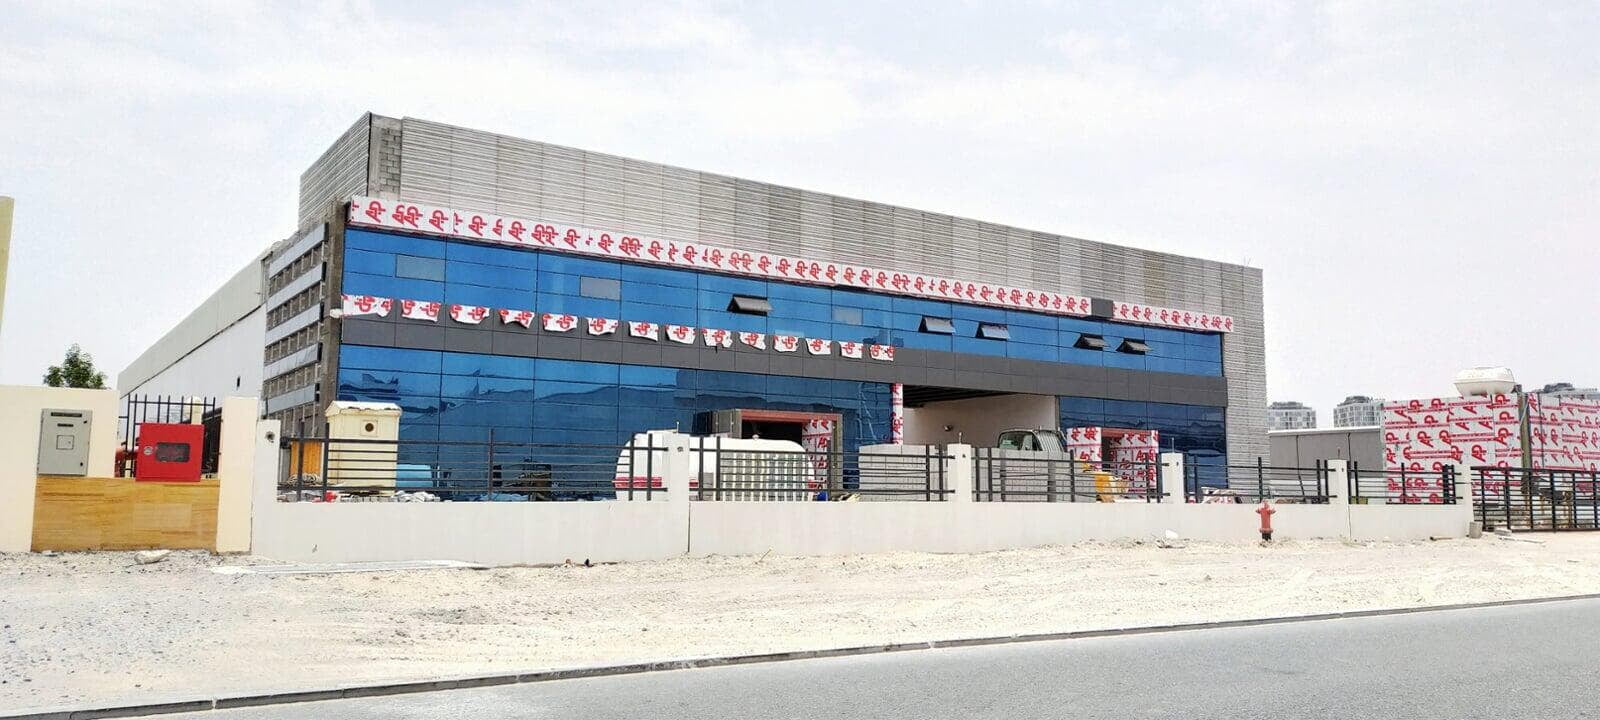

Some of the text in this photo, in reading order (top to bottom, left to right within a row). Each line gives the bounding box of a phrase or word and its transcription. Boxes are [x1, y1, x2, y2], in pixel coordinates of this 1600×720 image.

[366, 200, 386, 223] AP
[429, 210, 449, 232] AP
[469, 216, 488, 236] AP
[508, 221, 526, 242] AP
[564, 228, 581, 248] AP
[598, 233, 614, 254] AP
[648, 240, 664, 260] AP
[682, 246, 698, 264] AP
[1418, 431, 1434, 448] AP
[1494, 428, 1514, 446] AP
[1472, 444, 1487, 463] AP
